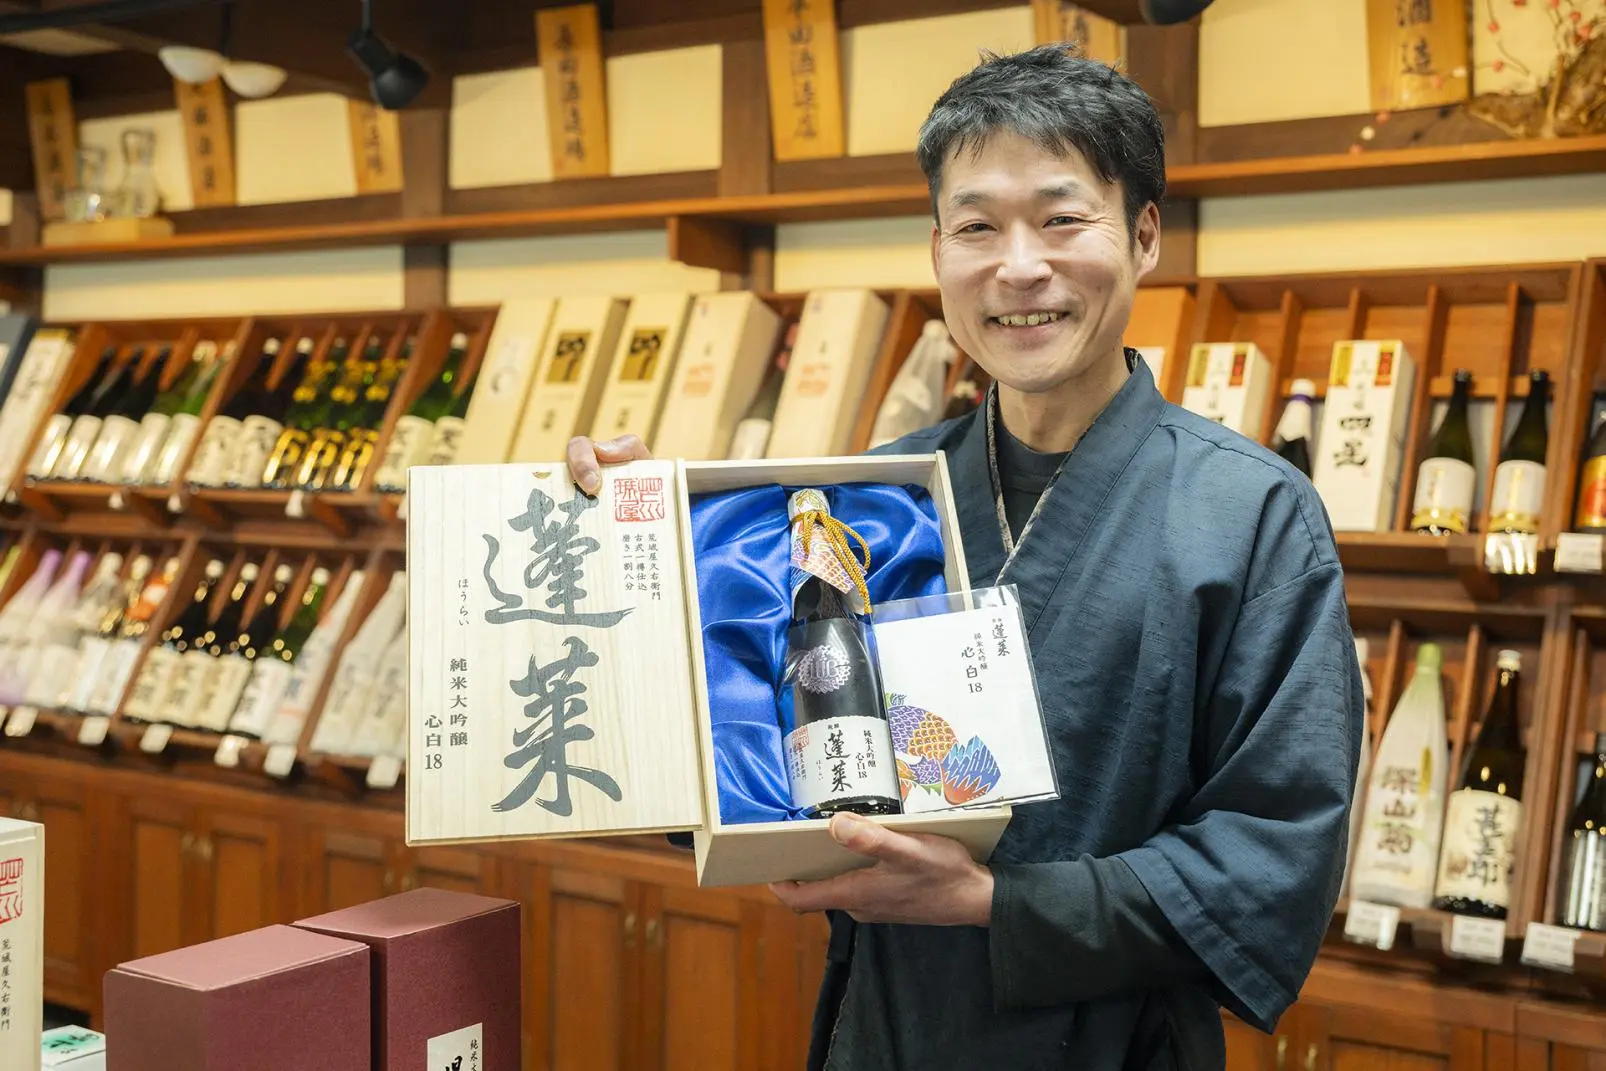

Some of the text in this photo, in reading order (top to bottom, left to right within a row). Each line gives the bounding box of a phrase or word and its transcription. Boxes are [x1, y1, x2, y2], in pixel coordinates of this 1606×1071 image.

[458, 578, 469, 626] ほうらい
[482, 487, 636, 817] 蓬莱
[992, 623, 1010, 656] 蓬莱
[450, 658, 468, 747] 純米大吟醸
[824, 729, 852, 792] 蓬莱
